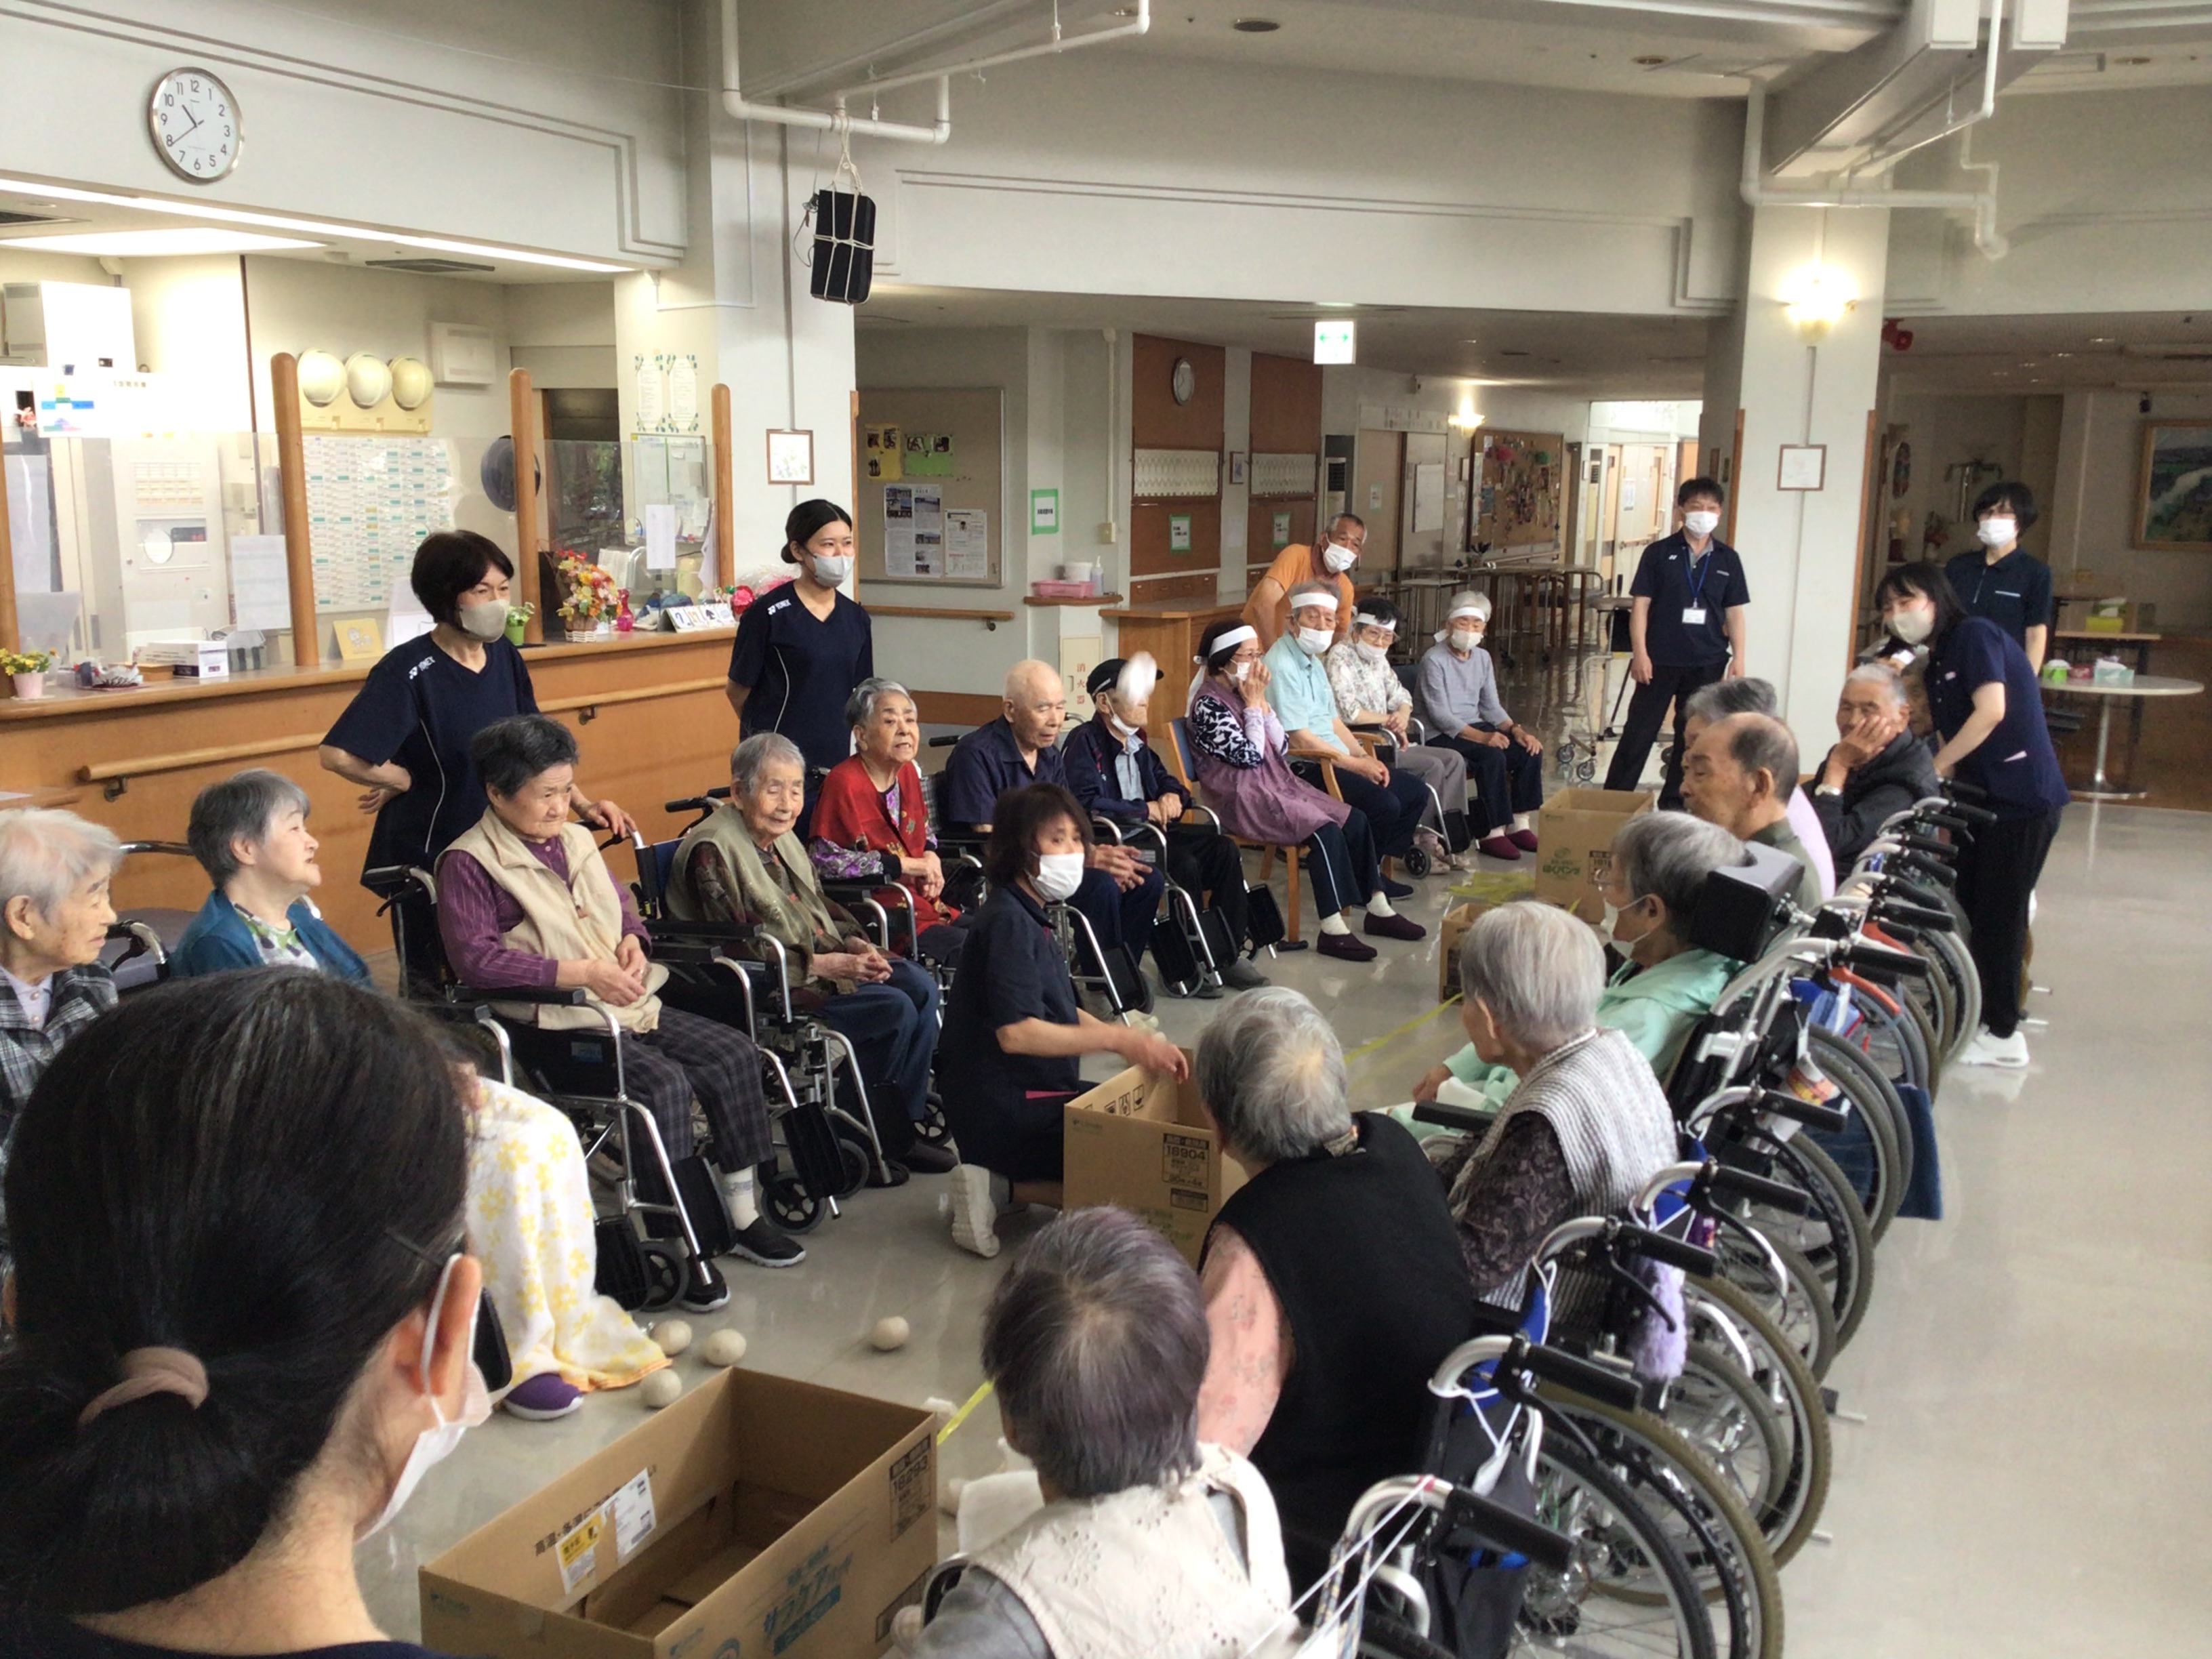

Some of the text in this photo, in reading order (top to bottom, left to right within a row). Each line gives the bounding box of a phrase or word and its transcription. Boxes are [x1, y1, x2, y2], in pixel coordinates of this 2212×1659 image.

[176, 82, 184, 96] 11
[190, 79, 200, 93] 12
[164, 93, 174, 107] 10
[208, 88, 212, 101] 1
[218, 104, 225, 117] 2
[160, 113, 168, 125] 9
[224, 125, 230, 137] 3
[166, 134, 173, 147] 8
[179, 150, 186, 163] 7
[220, 144, 227, 156] 4
[193, 158, 201, 170] 6
[209, 155, 216, 167] 5
